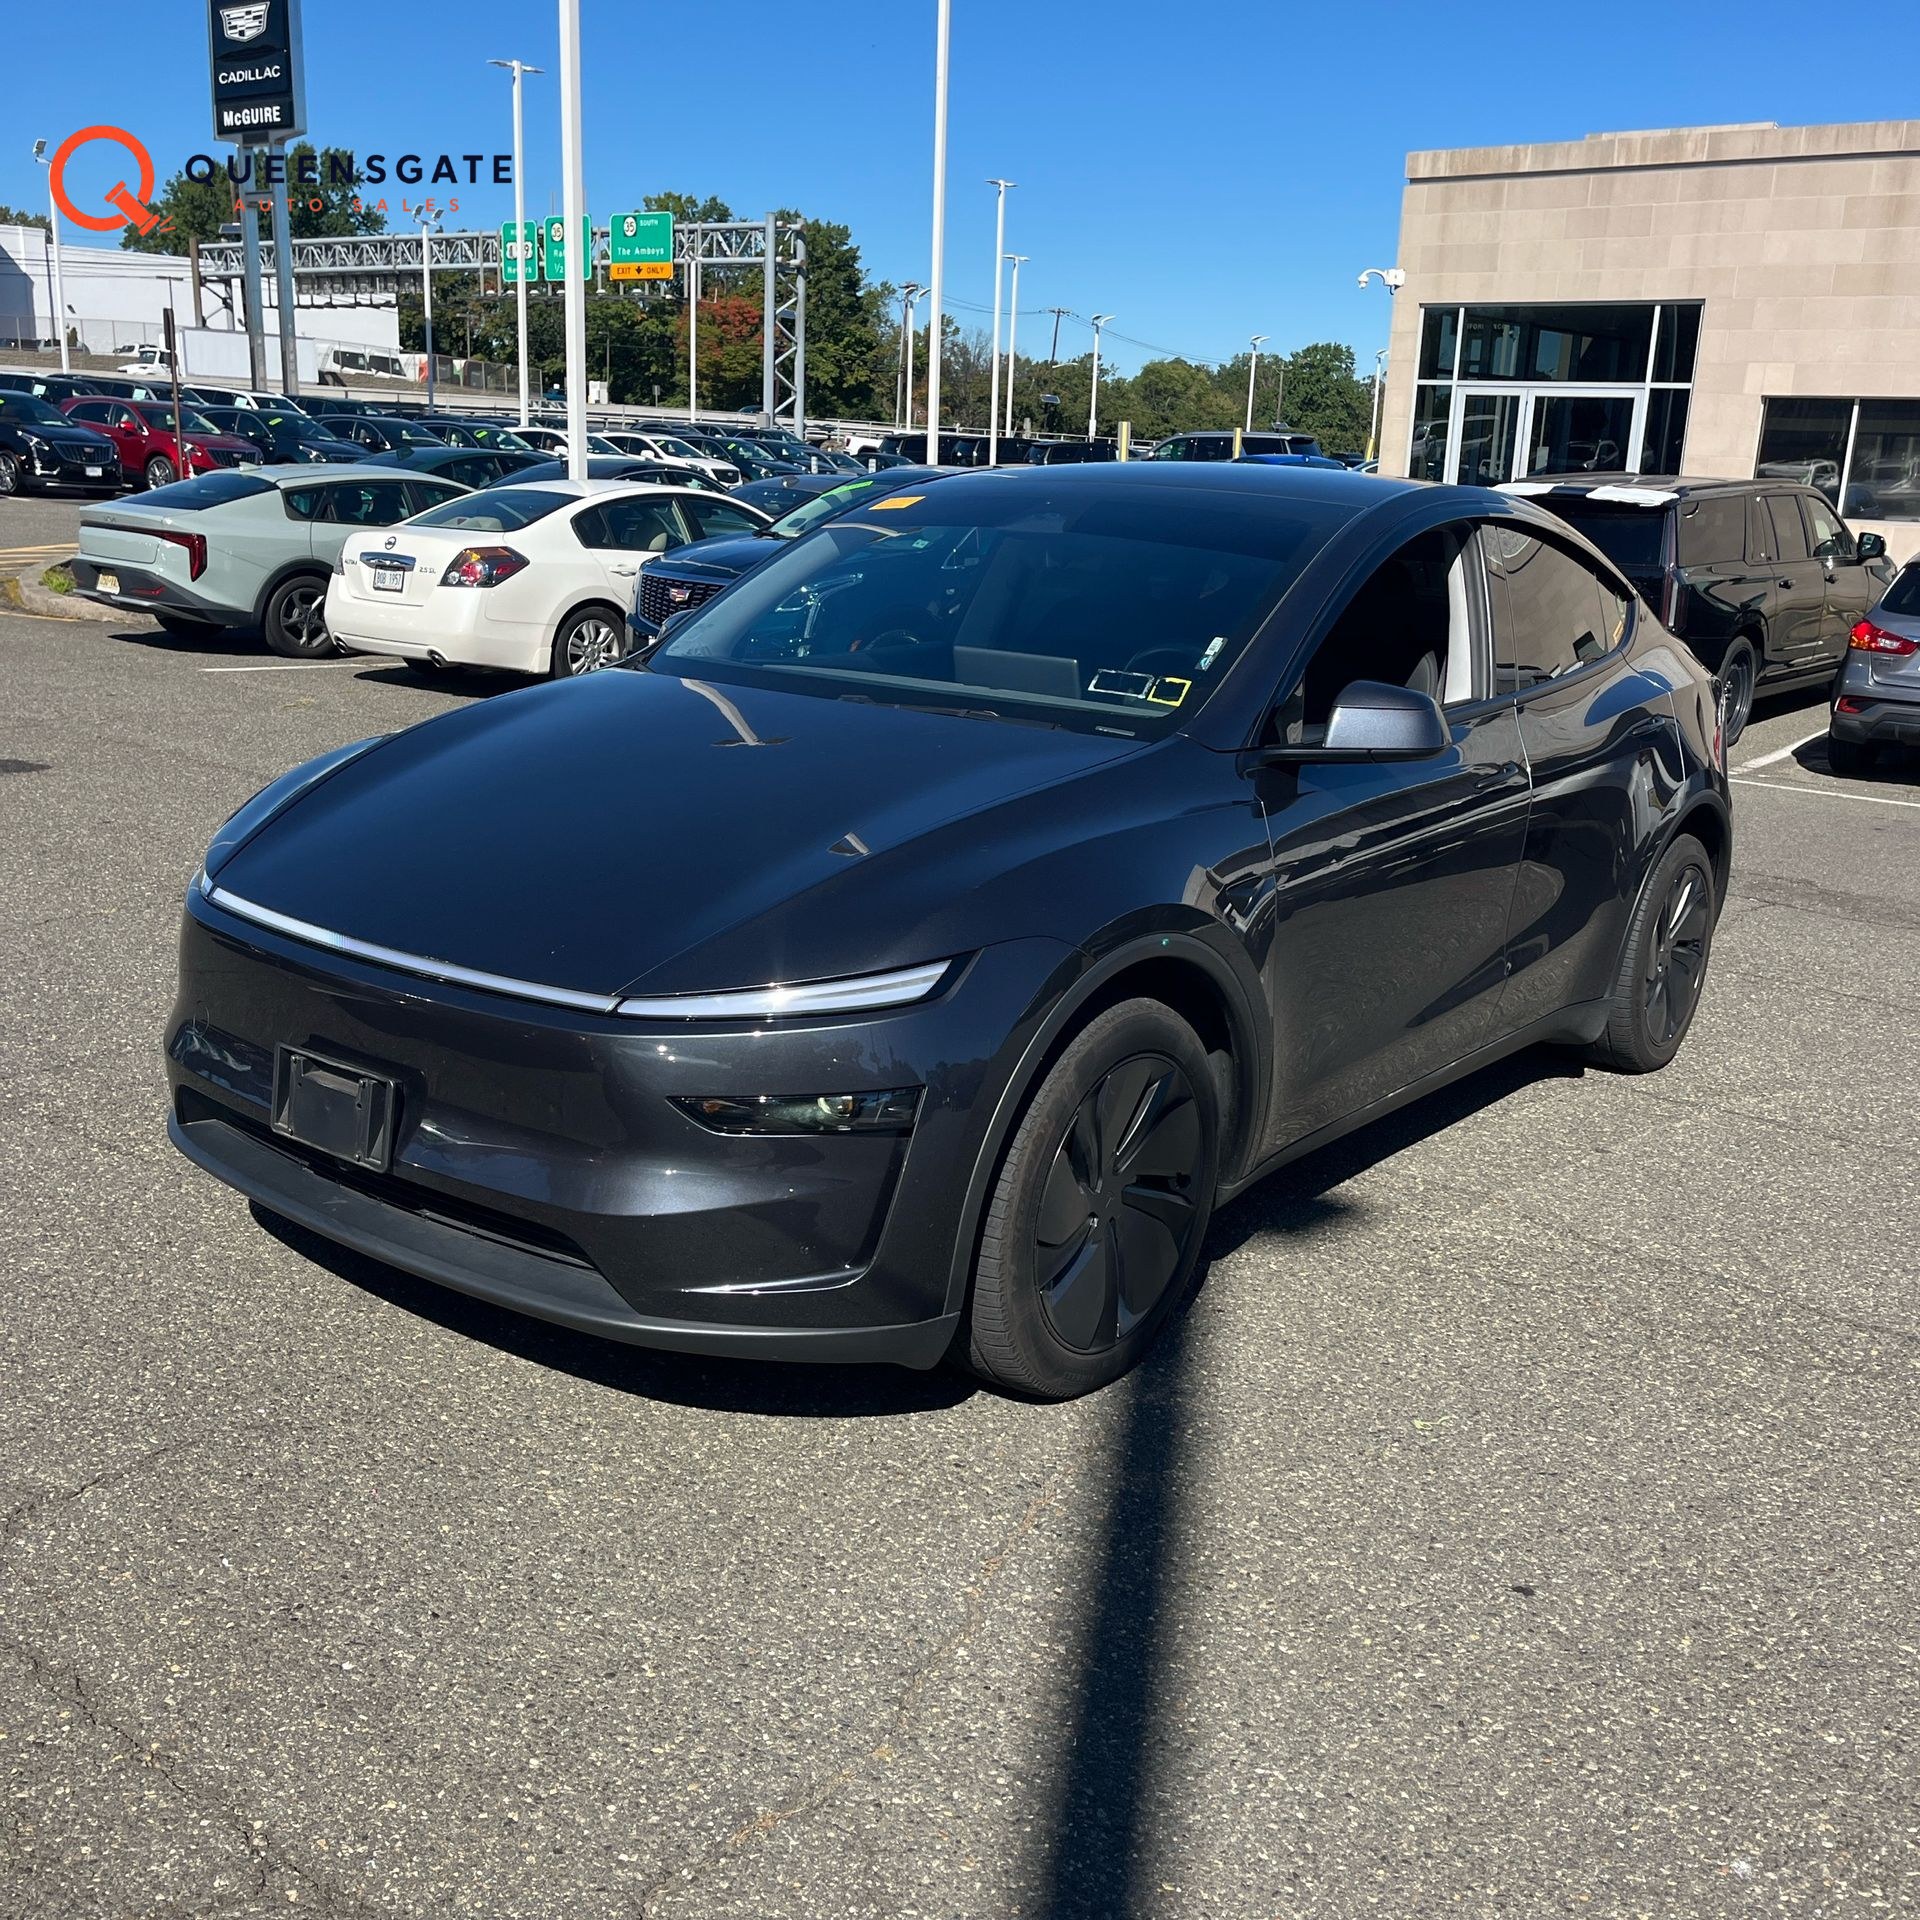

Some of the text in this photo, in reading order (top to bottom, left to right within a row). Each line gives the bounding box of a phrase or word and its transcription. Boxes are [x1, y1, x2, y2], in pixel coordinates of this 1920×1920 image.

[218, 65, 281, 85] CADILLAC
[223, 105, 282, 127] McGUIRE
[552, 226, 562, 238] 35
[624, 219, 659, 233] 35 SOUTH
[617, 246, 665, 257] The Amboys
[617, 266, 665, 275] EXIT ONLY
